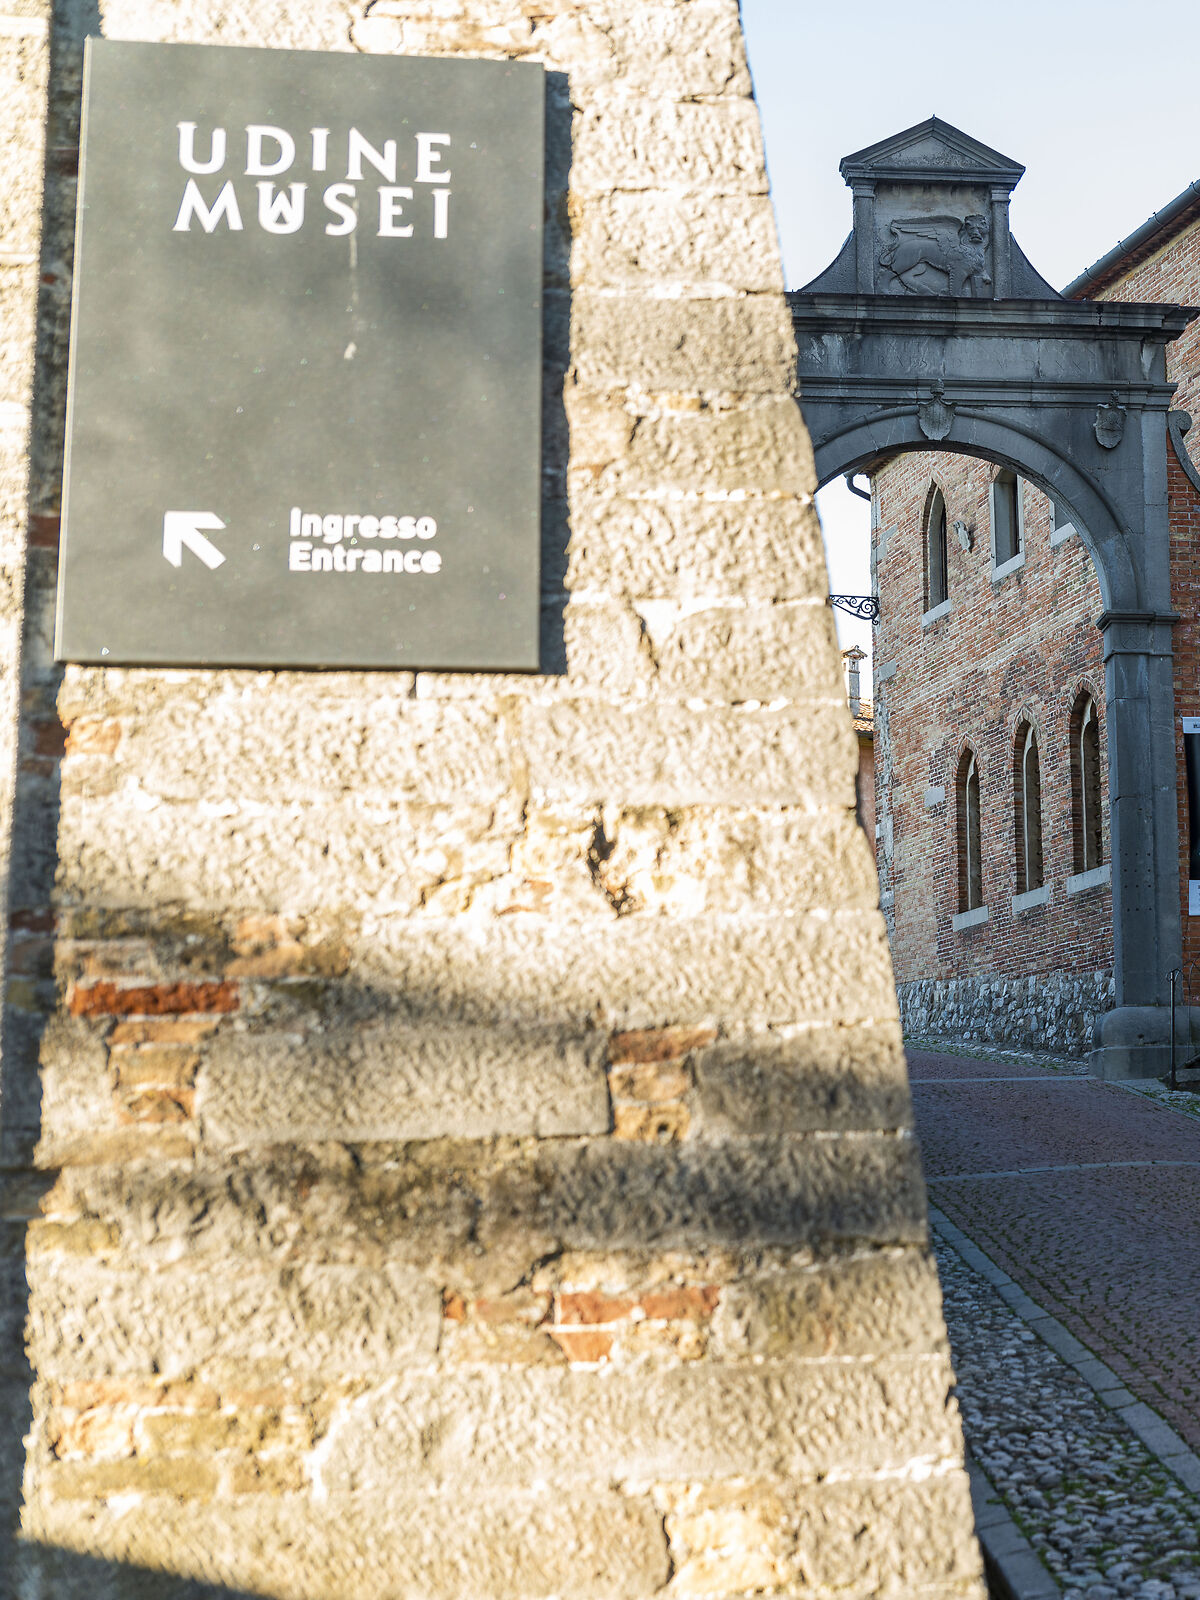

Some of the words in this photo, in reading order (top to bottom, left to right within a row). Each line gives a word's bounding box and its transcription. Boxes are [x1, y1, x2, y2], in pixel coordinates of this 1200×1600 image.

[175, 120, 452, 184] UDINE
[172, 178, 452, 239] MUSEI
[288, 506, 438, 545] Ingresso
[288, 540, 444, 574] Entrance
